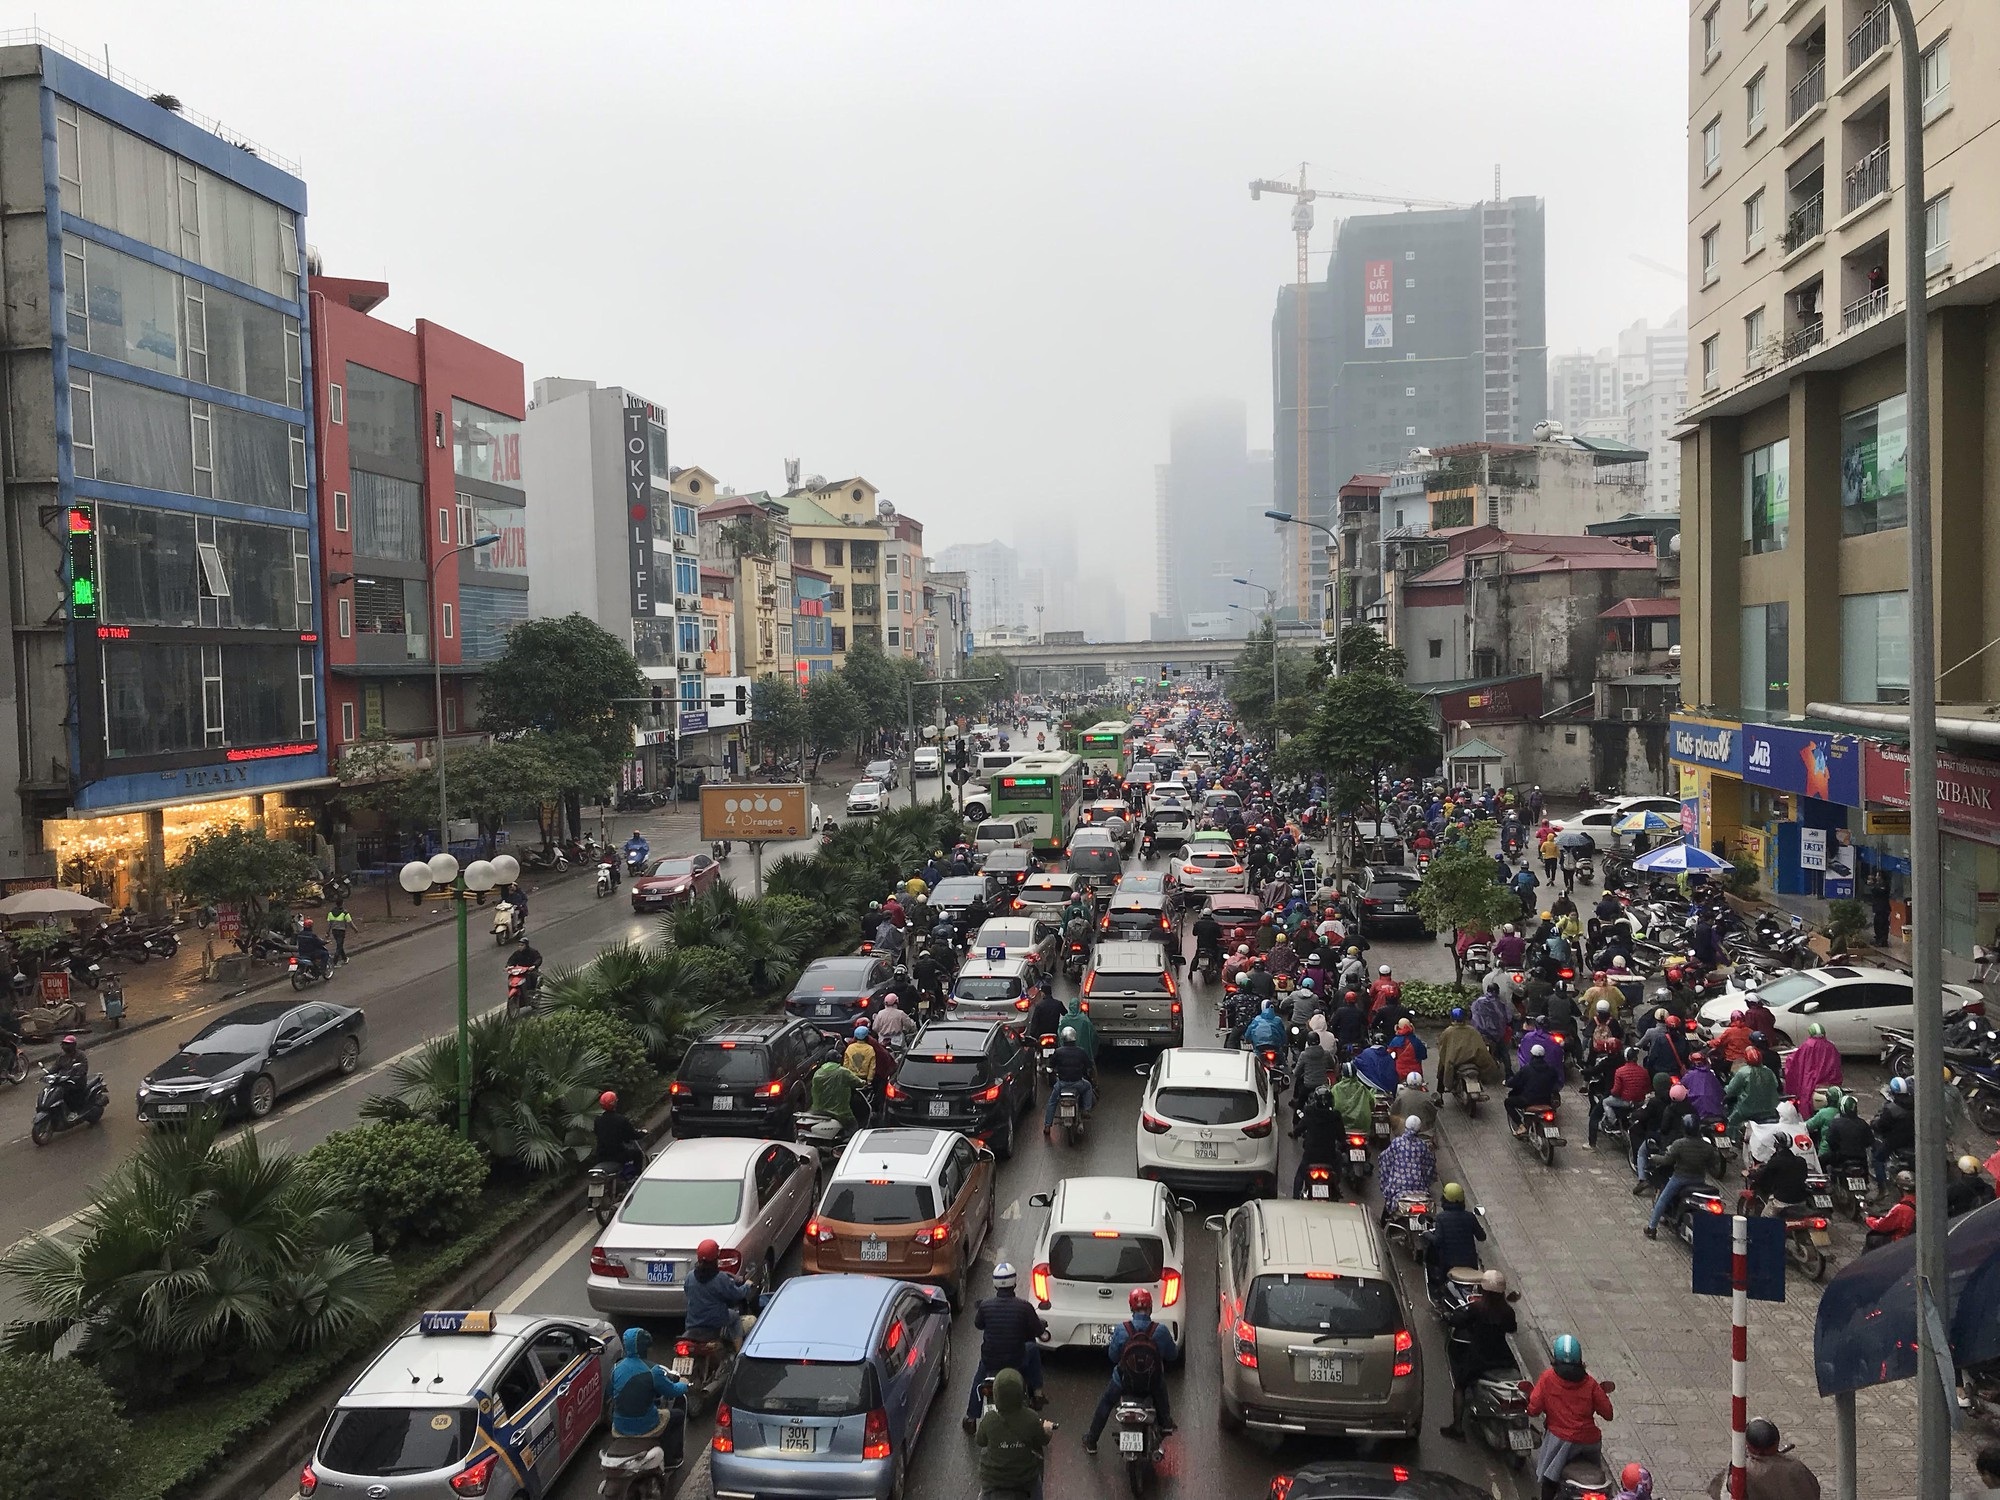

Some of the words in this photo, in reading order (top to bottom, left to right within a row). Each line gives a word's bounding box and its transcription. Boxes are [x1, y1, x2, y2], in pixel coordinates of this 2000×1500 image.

[1374, 265, 1385, 277] LỄ
[1369, 278, 1388, 290] CẤT
[1369, 292, 1389, 303] NÓC
[109, 626, 130, 639] THẤT
[1676, 730, 1693, 755] Kids
[1695, 735, 1719, 761] plaza
[185, 766, 248, 788] ITALY
[1937, 779, 1992, 810] RIBANK
[726, 813, 736, 826] 4
[741, 815, 783, 826] Oranges
[991, 948, 1000, 958] G7
[653, 1263, 667, 1273] 80A
[1317, 1359, 1335, 1369] 30E
[788, 1427, 808, 1439] 30V
[786, 1439, 809, 1450] 1755
